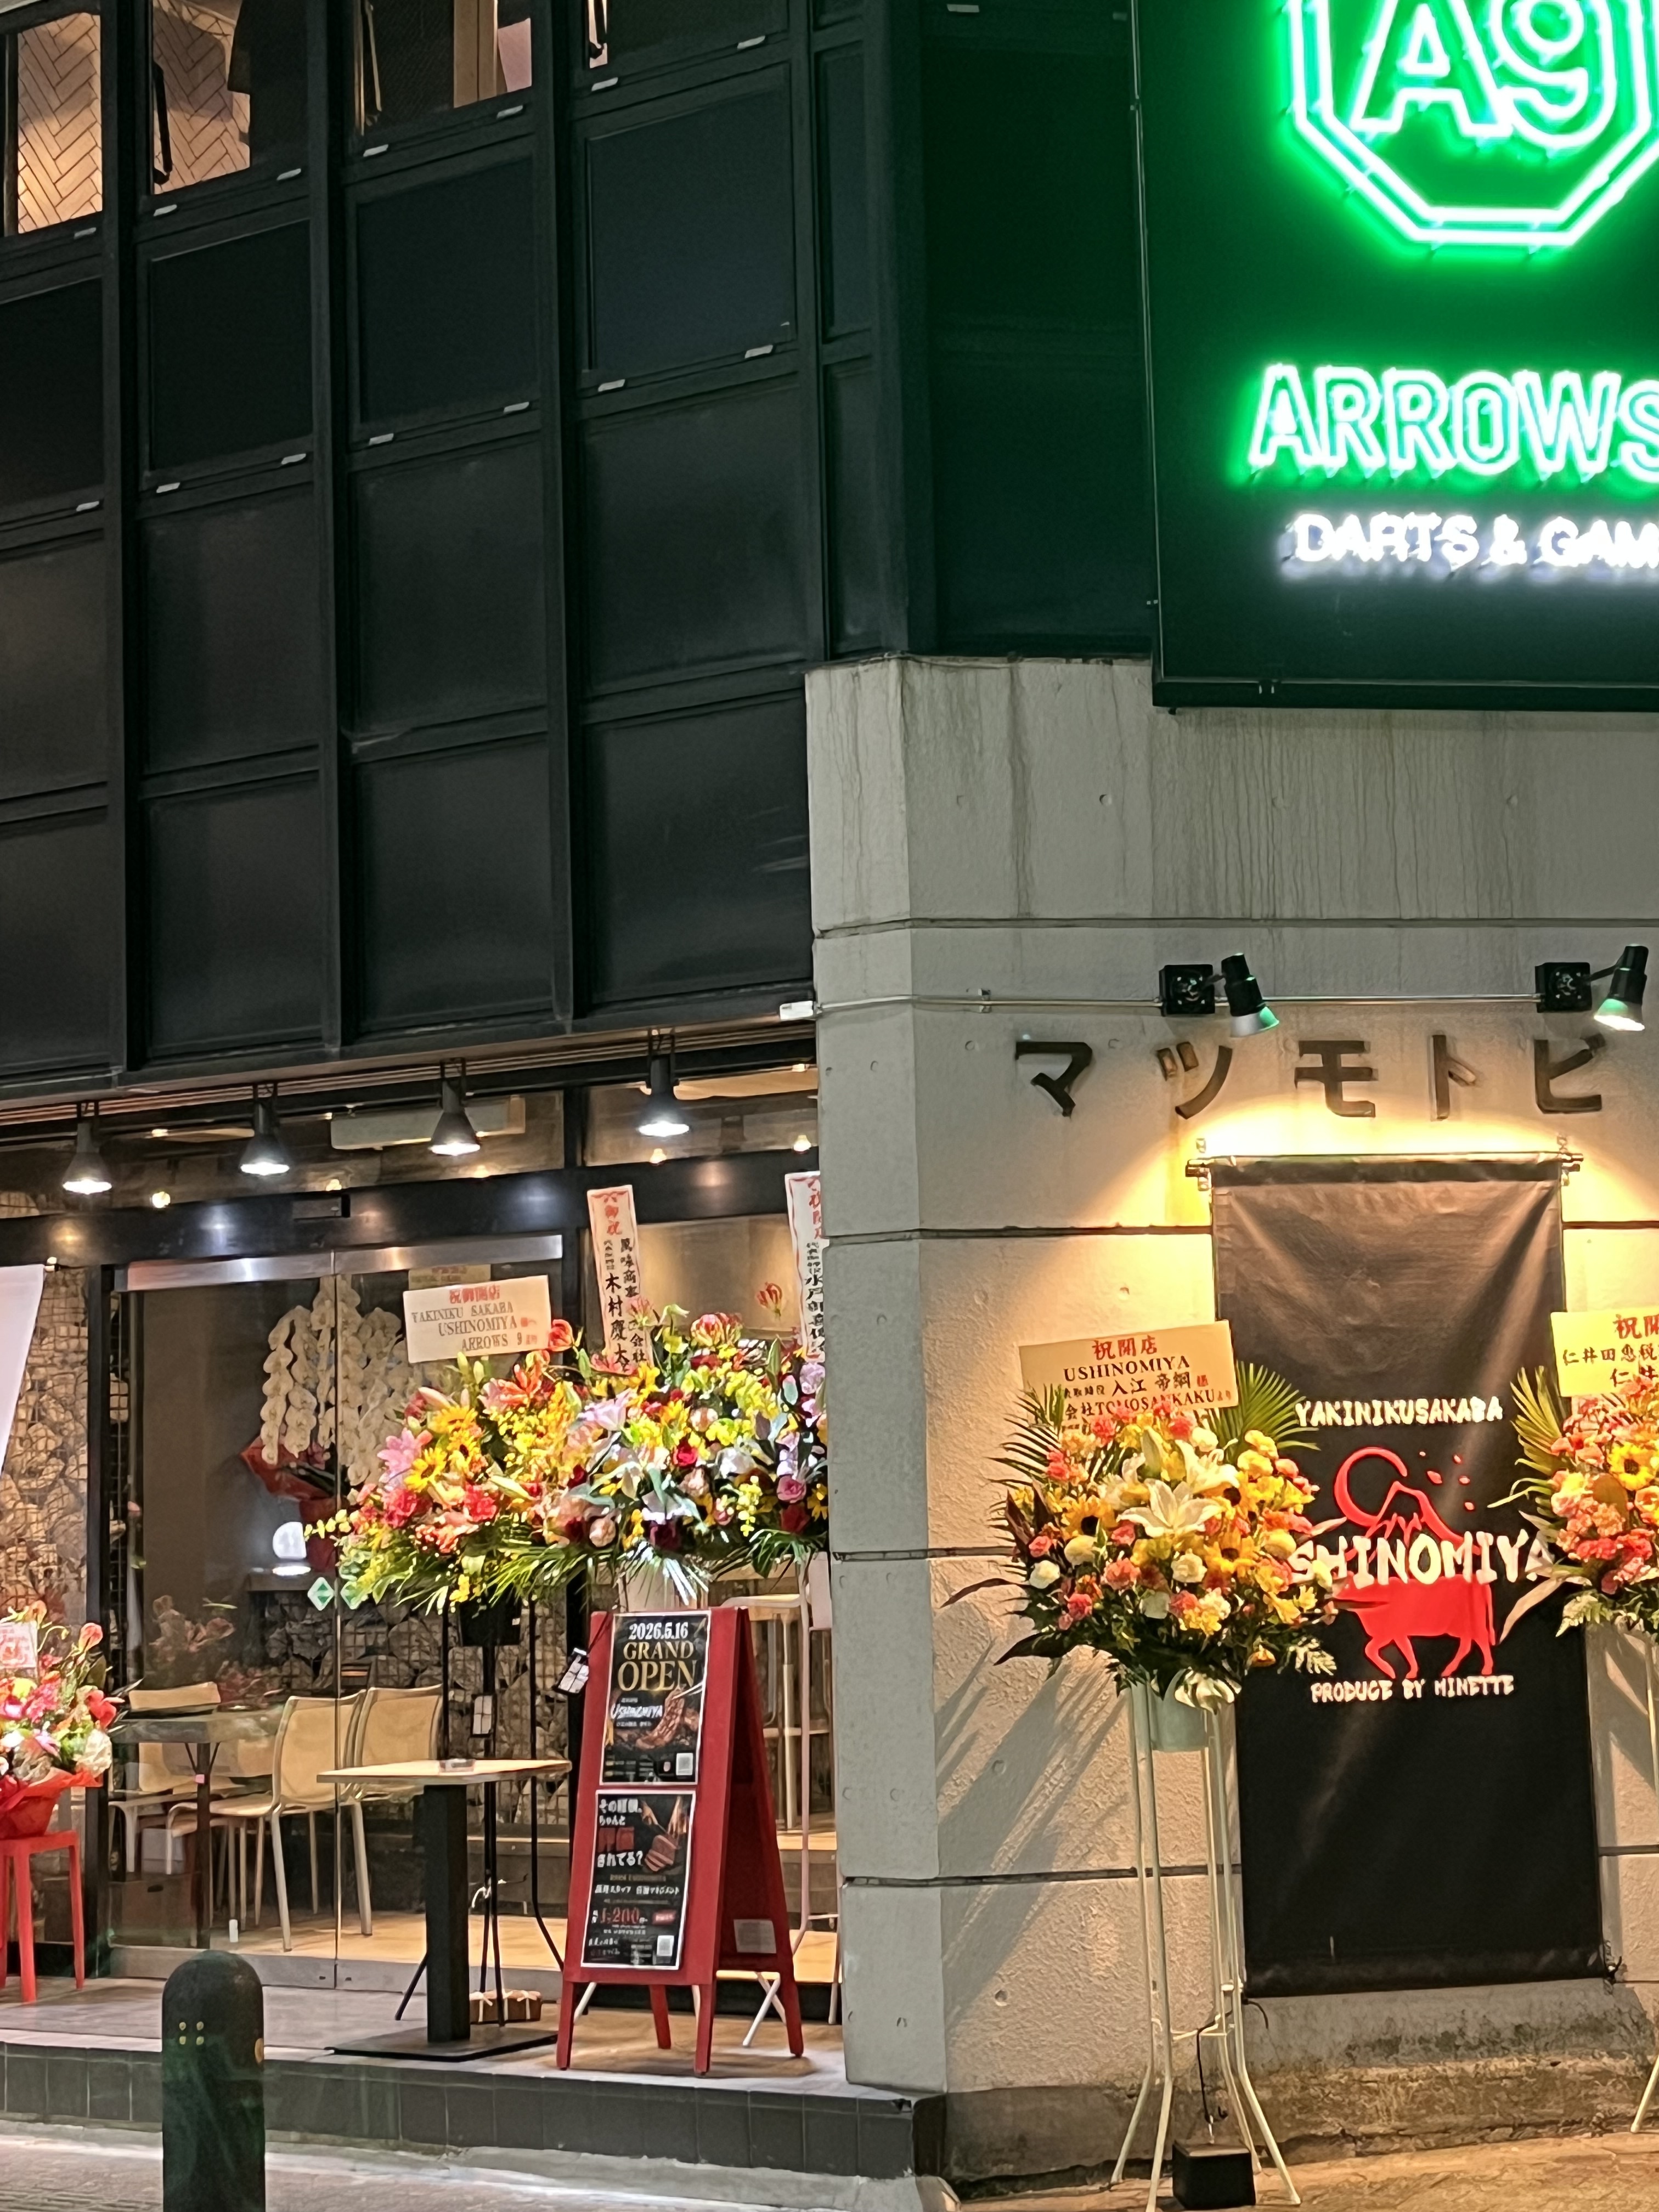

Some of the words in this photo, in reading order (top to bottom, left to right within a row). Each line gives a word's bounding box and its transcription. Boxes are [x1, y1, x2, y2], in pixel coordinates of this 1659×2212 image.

[1249, 362, 1659, 484] ARROWS
[1294, 512, 1480, 566] DARTS
[1488, 515, 1527, 566] &
[471, 1301, 514, 1317] SAKABA
[439, 1316, 517, 1336] USHINOMIYA
[461, 1334, 508, 1351] ARROWS
[1092, 1335, 1158, 1361] 祝開店
[1063, 1355, 1190, 1382] USHINOMIYA
[1295, 1396, 1503, 1427] YAKINIKUSAKABA
[1287, 1528, 1556, 1589] SHINOMIYA
[628, 1622, 689, 1640] 2026.5.16
[623, 1640, 695, 1660] GRAND
[617, 1660, 697, 1691] OPEN
[1311, 1680, 1393, 1703] PRODUCE
[1402, 1679, 1426, 1699] BY
[1434, 1675, 1515, 1699] MINETTE
